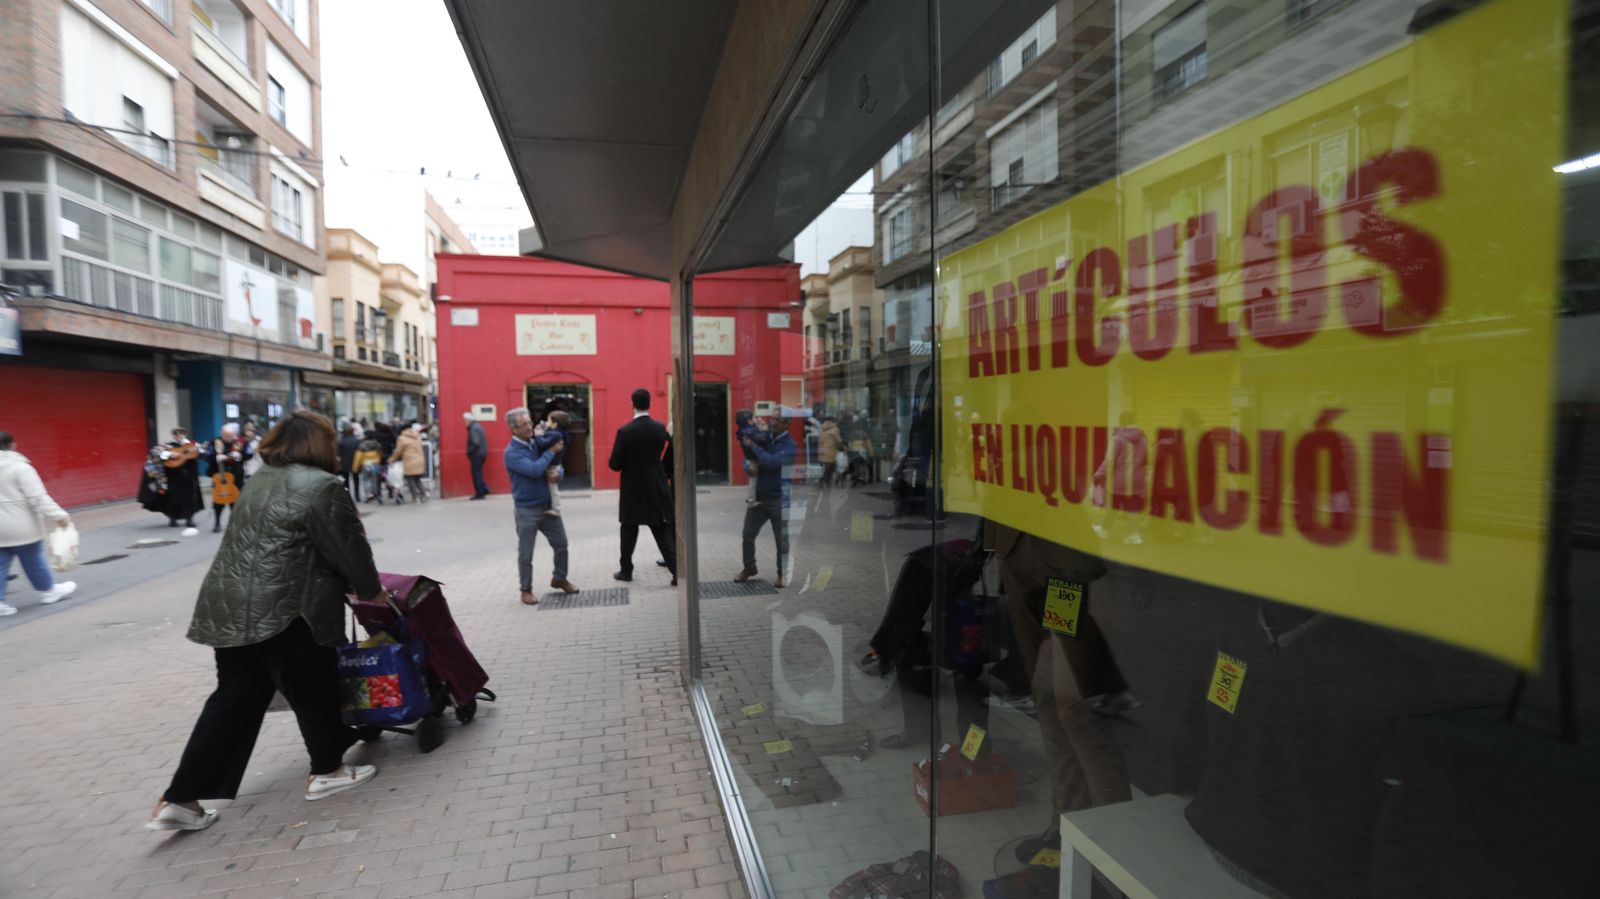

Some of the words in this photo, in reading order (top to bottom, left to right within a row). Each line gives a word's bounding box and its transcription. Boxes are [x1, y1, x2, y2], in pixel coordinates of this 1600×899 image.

[971, 422, 1003, 487] EN
[1011, 408, 1450, 564] LIQUIDACIÓN
[1048, 578, 1083, 592] REBAJAS
